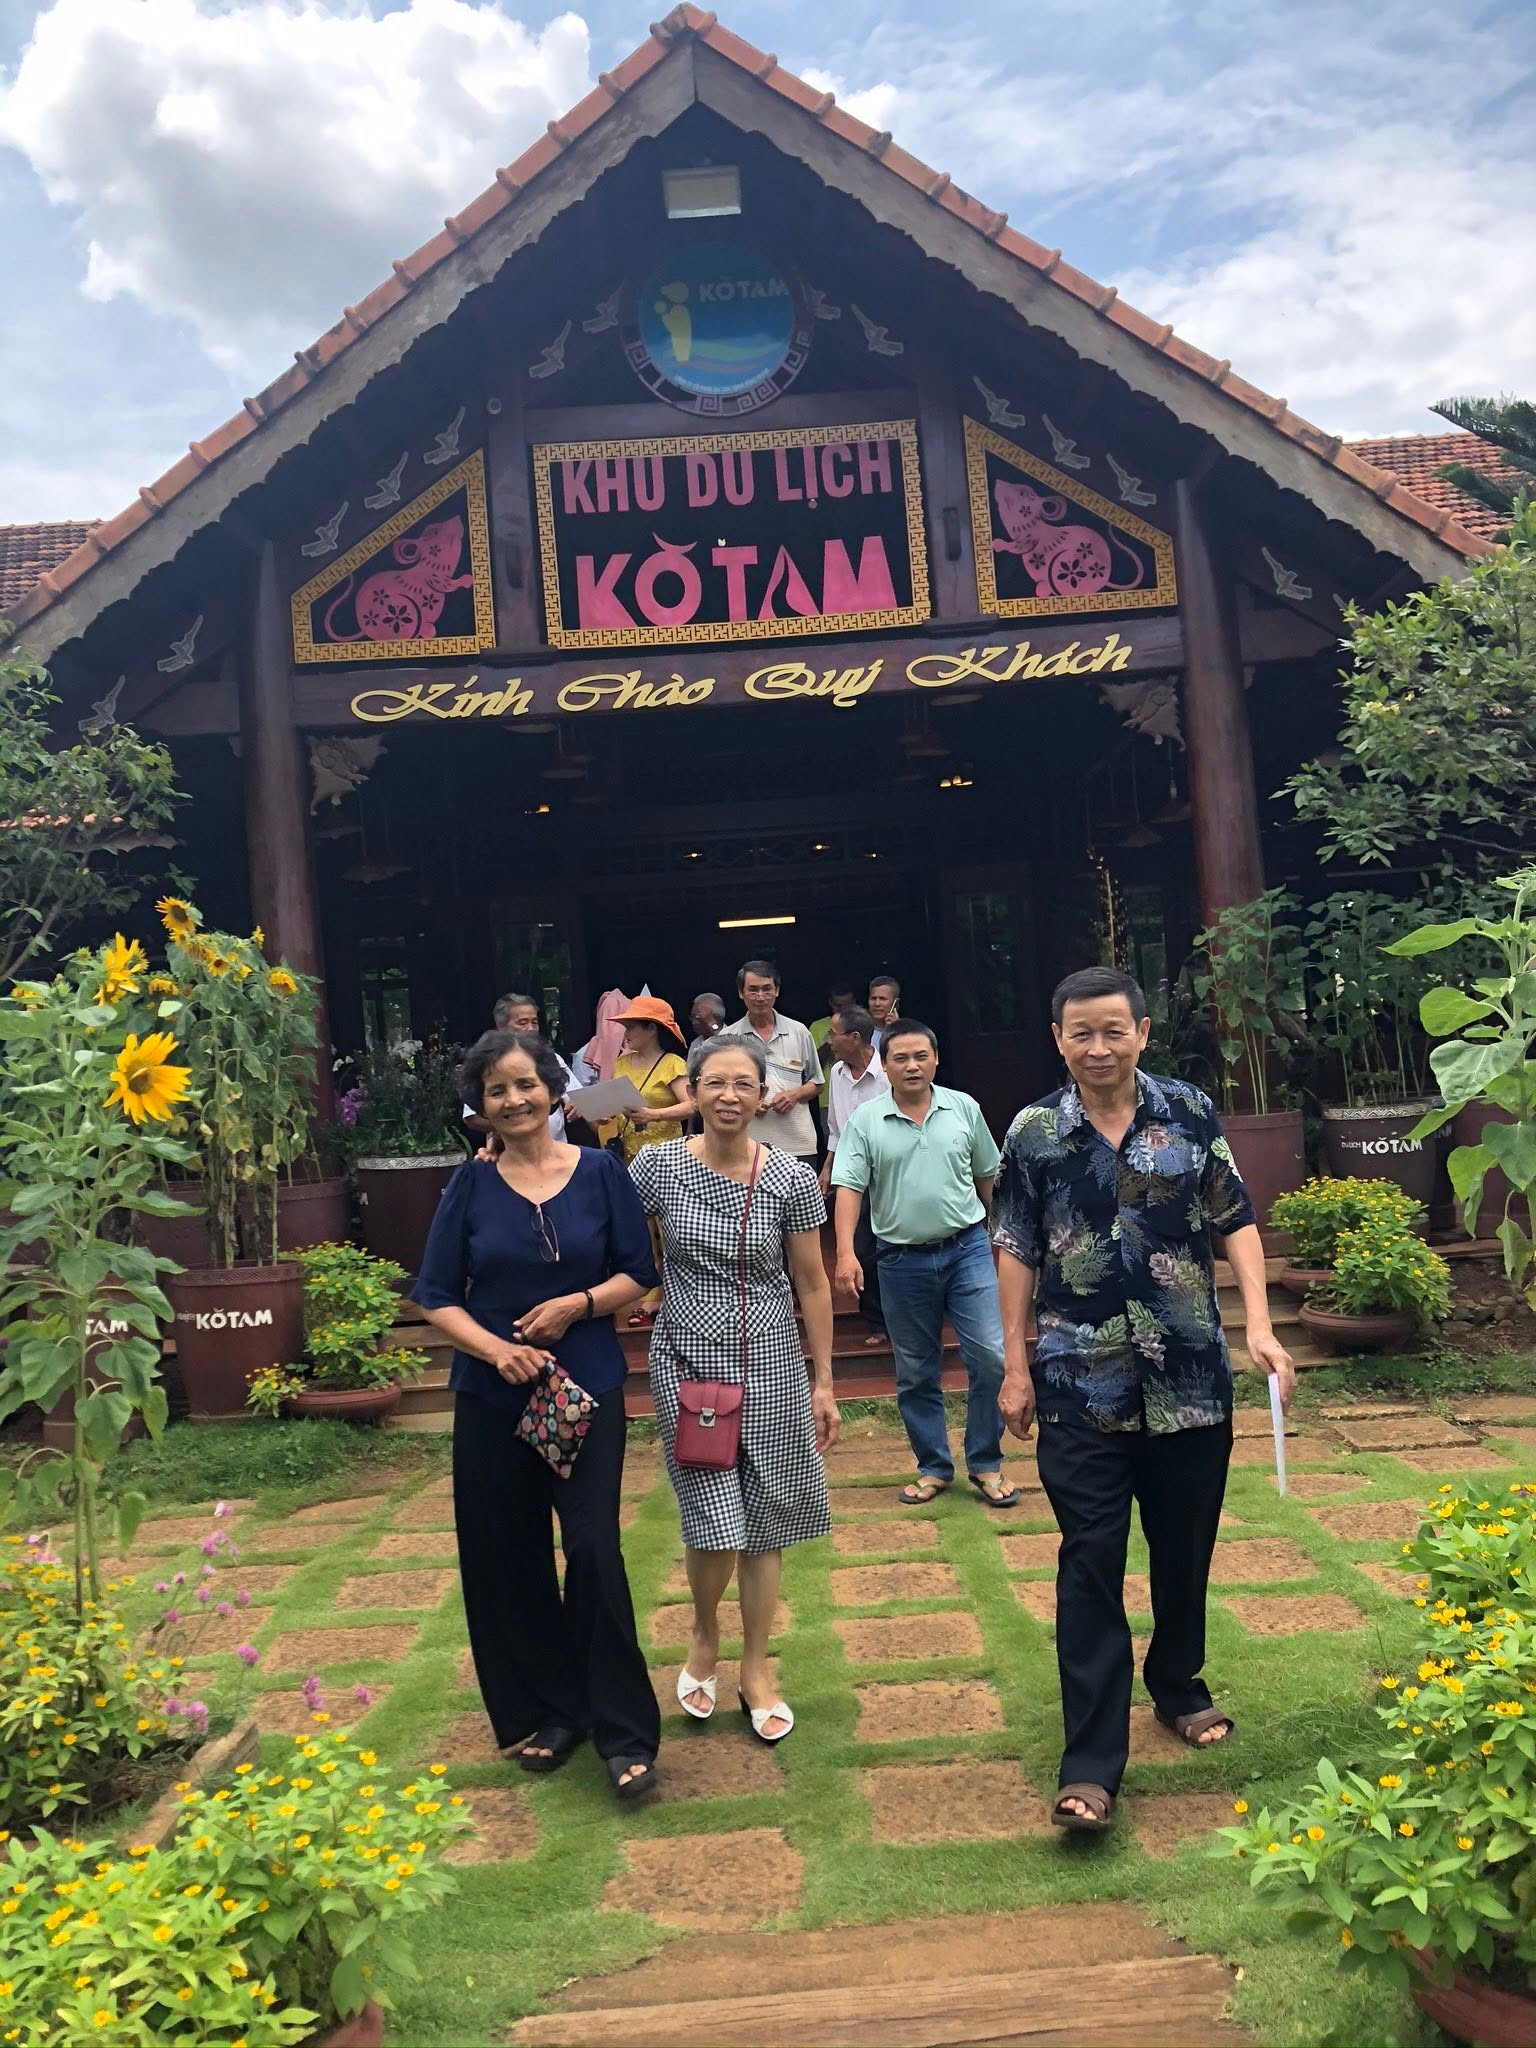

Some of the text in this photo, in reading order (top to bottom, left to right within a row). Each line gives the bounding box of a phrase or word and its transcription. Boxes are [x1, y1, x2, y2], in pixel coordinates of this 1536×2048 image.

[562, 439, 893, 515] KHU DU LỊCH
[351, 674, 535, 723] Kính
[557, 669, 717, 712] Chào
[905, 632, 1133, 687] Khách
[85, 1318, 129, 1336] TAM
